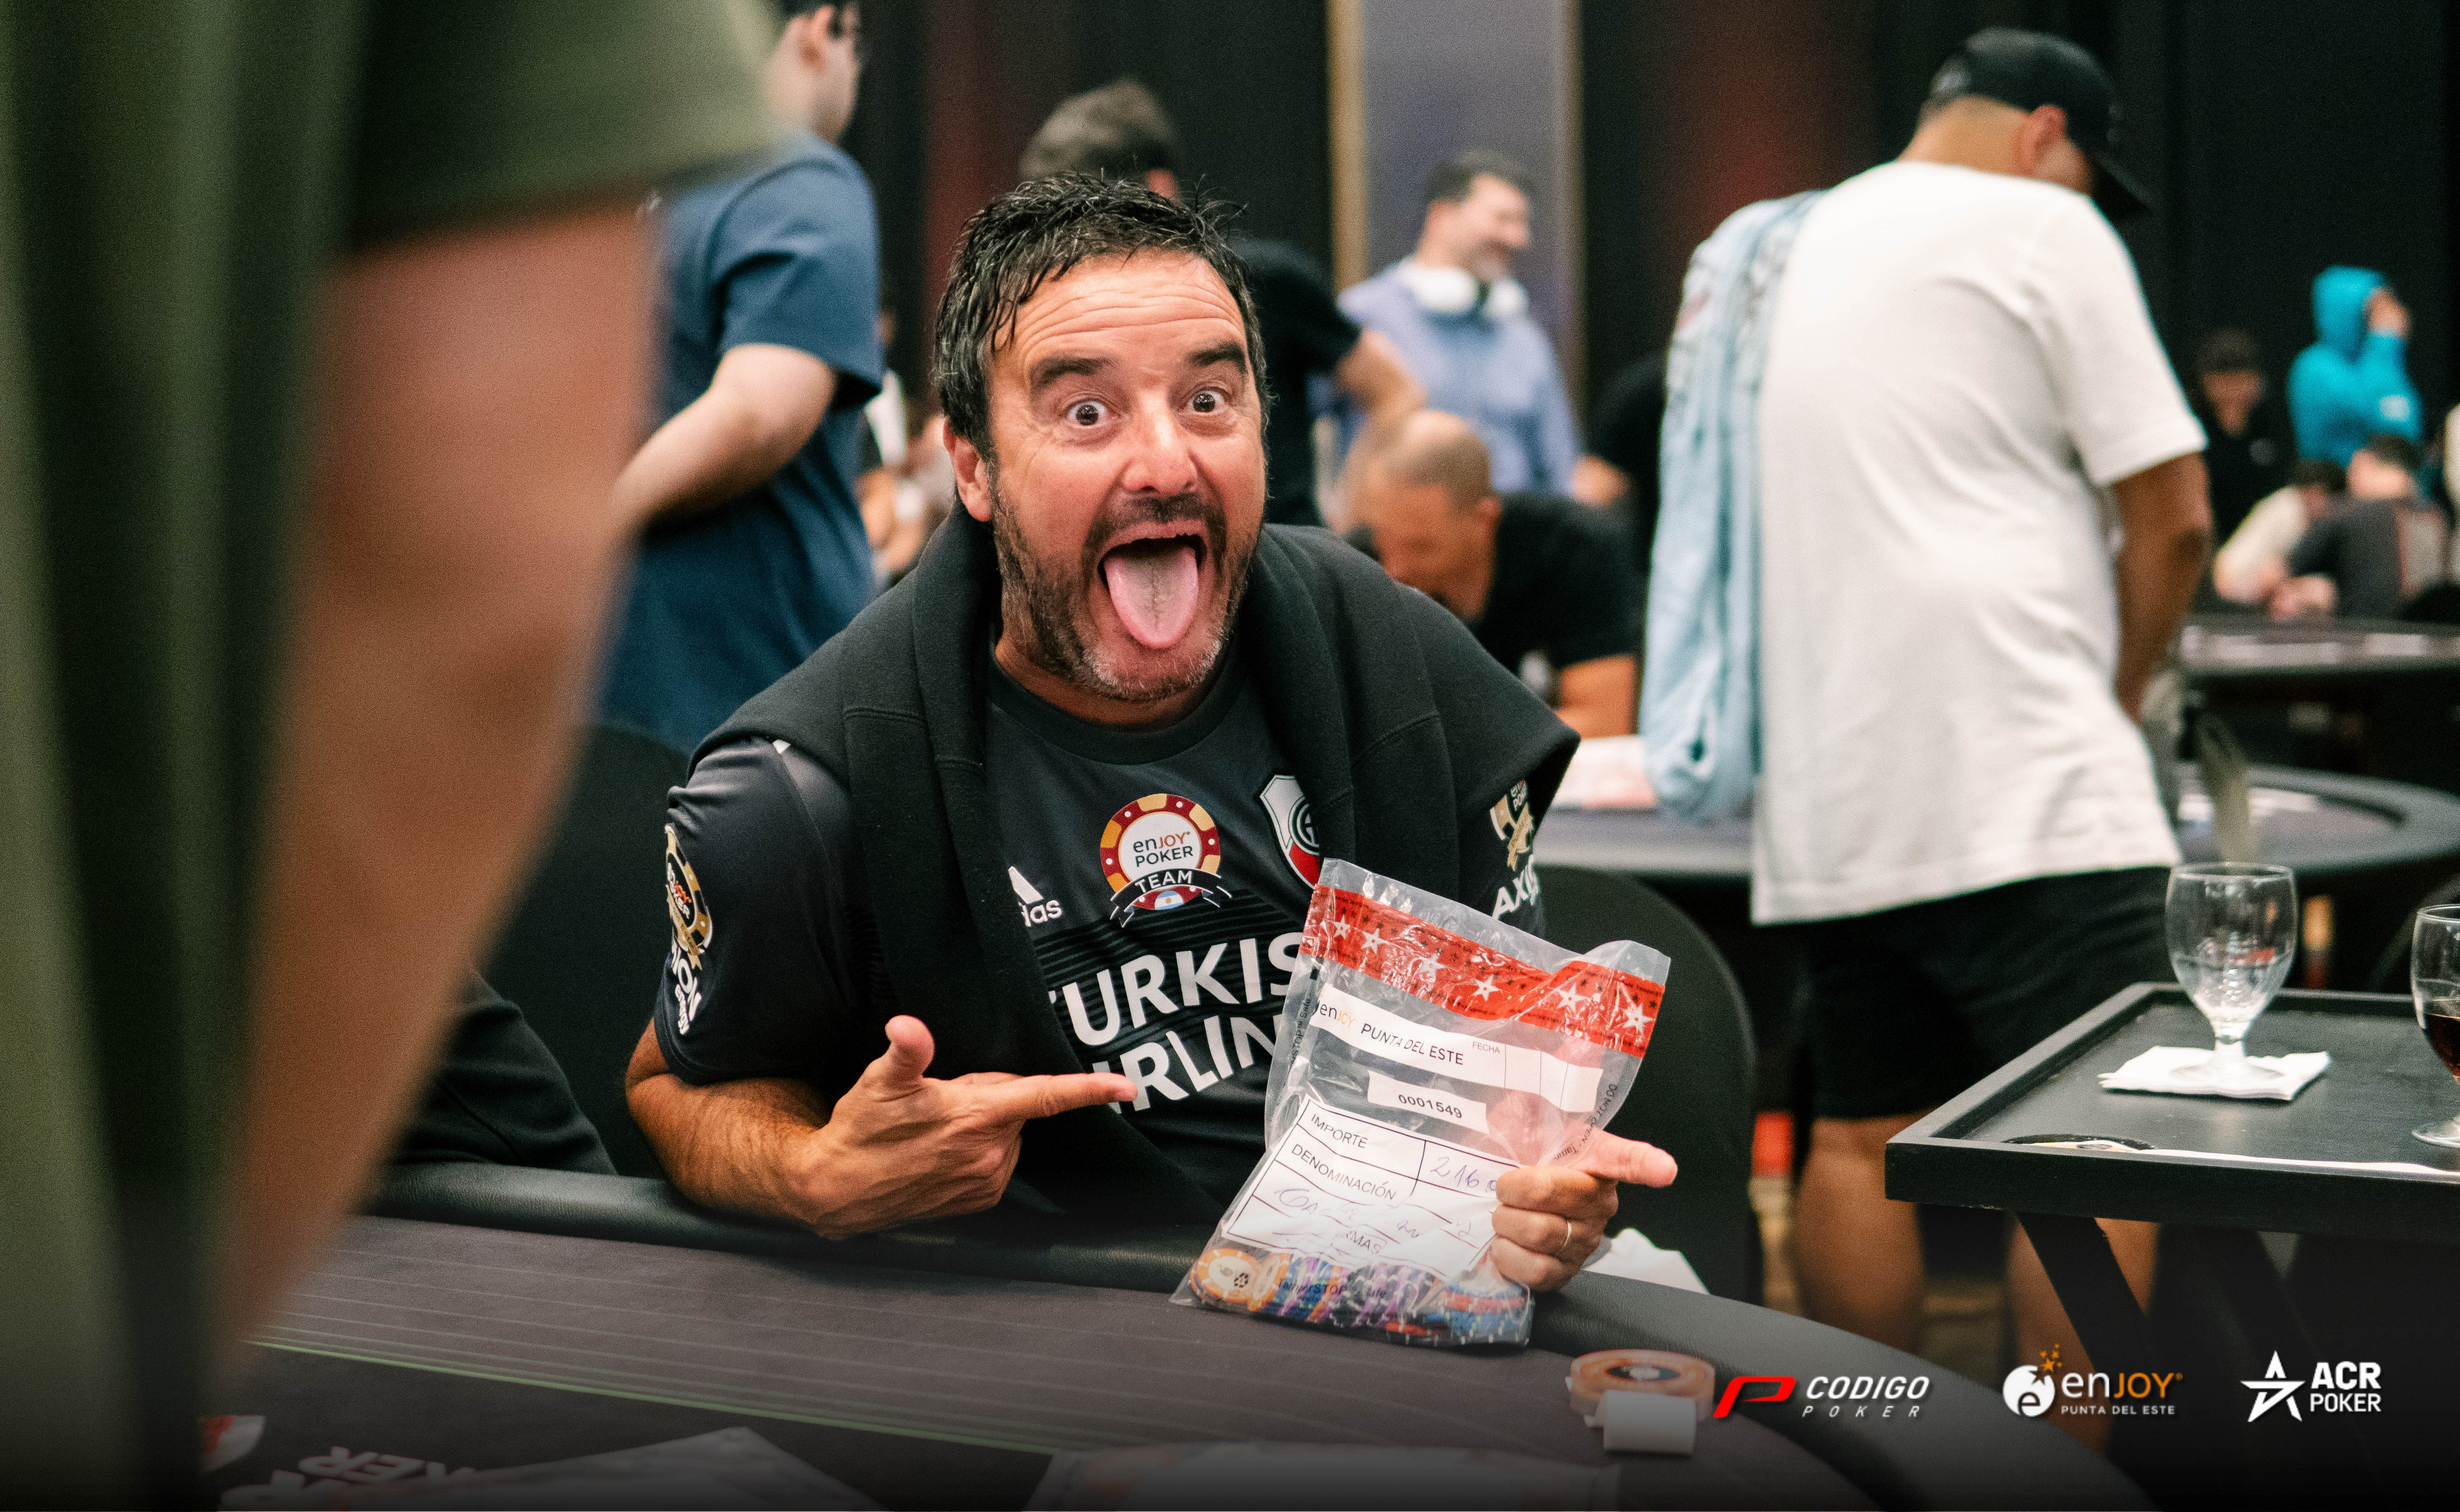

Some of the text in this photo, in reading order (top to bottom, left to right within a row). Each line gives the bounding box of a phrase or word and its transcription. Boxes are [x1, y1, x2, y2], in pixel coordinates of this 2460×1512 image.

[1135, 846, 1193, 867] POKER
[1135, 870, 1192, 893] TEAM
[1048, 931, 1305, 1045] URKIS
[1361, 1022, 1401, 1047] PUNTA
[1404, 1039, 1425, 1055] DEL
[1429, 1045, 1464, 1066] ESTE
[1472, 1041, 1501, 1054] FECHA
[1398, 1094, 1462, 1119] 0001549
[1311, 1113, 1369, 1149] IMPORTE
[1291, 1143, 1397, 1200] DENOMINACIÓN
